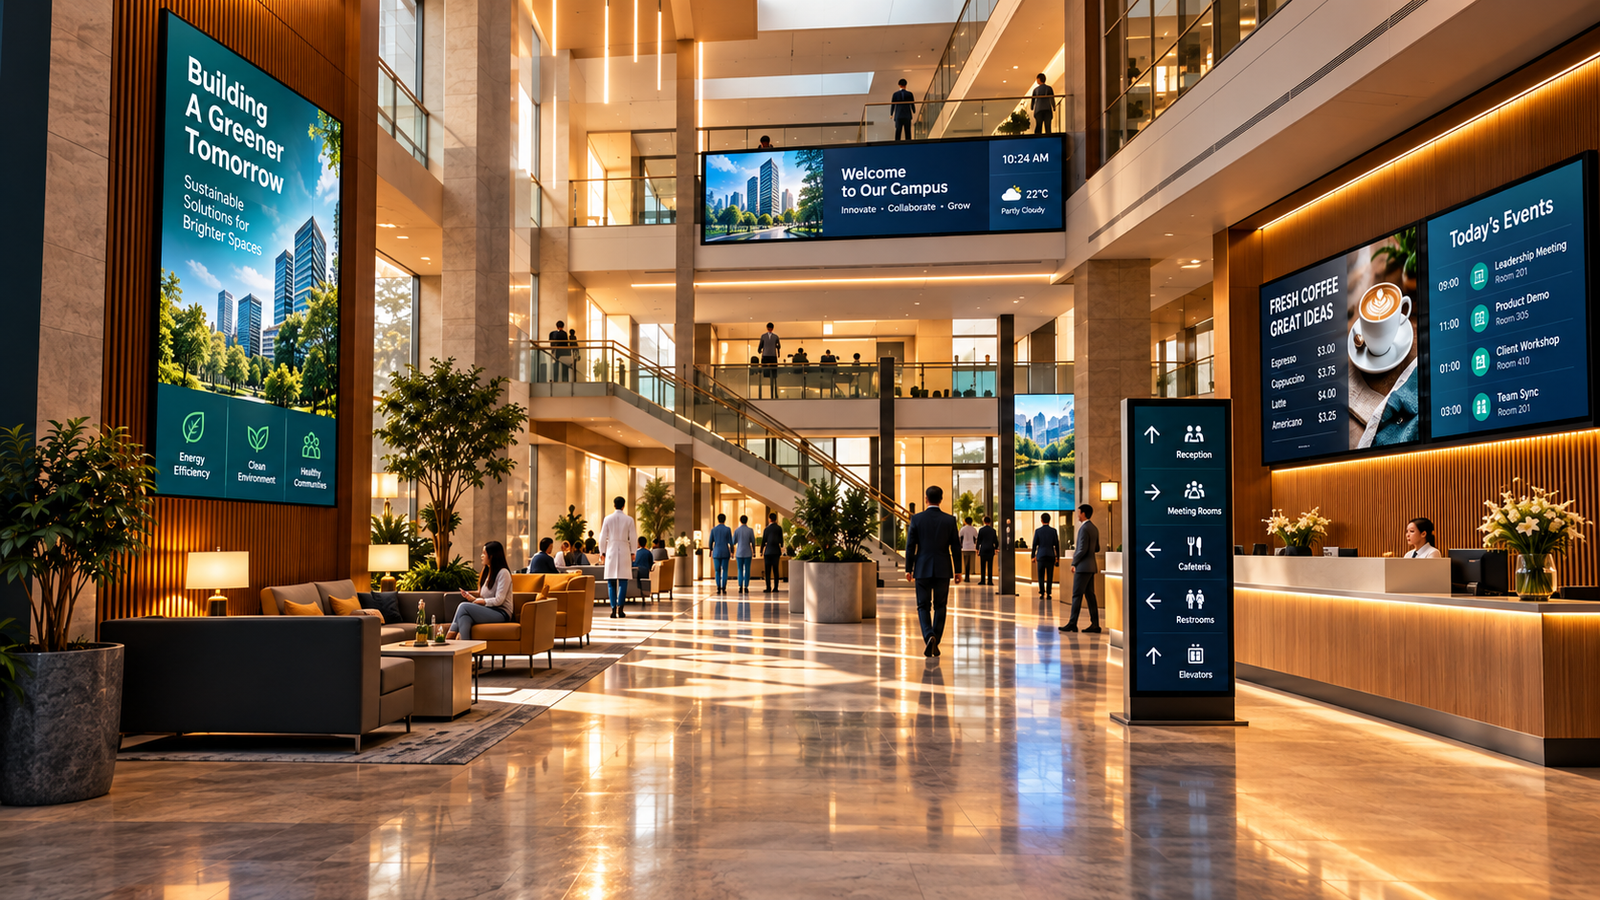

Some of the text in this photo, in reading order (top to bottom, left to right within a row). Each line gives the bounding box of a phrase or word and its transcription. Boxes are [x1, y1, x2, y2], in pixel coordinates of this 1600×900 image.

[188, 56, 267, 128] Building
[185, 93, 284, 163] A Greener
[185, 126, 284, 195] Tomorrow
[1003, 153, 1049, 164] 10:24 AM
[842, 167, 907, 181] Welcome
[184, 175, 244, 212] Sustainable
[842, 183, 949, 198] to Our Campus
[183, 195, 249, 232] Solutions for
[842, 202, 971, 214] Innovate Collaborate Grow
[1002, 206, 1046, 216] Partly Cloudy
[1450, 199, 1554, 248] Today's Events
[183, 214, 262, 256] Brighter Spaces
[1495, 242, 1567, 271] Leadership Meeting
[1495, 267, 1528, 284] Room 201
[1439, 277, 1460, 292] 09:00
[1270, 276, 1339, 315] FRESH COFFEE
[1496, 291, 1550, 312] Product Demo
[1270, 303, 1334, 337] GREAT IDEAS
[1439, 318, 1460, 332] 11:00
[1496, 310, 1529, 326] Room 305
[1496, 336, 1560, 357] Client Workshop
[1271, 343, 1336, 369] Espresso $3.00
[1497, 355, 1530, 370] Room 410
[1440, 361, 1461, 374] 01:00
[1271, 365, 1337, 390] Cappuccino $3.75
[1272, 388, 1337, 410] Latte $4.00
[1497, 389, 1540, 403] Team Sync
[1441, 404, 1462, 417] 03:00
[1498, 404, 1531, 417] Room 201
[1272, 410, 1337, 430] Americano $3.25
[179, 452, 205, 466] Energy
[1177, 451, 1213, 461] Reception
[173, 466, 210, 479] Efficiency
[248, 461, 267, 471] Clean
[238, 472, 276, 485] Environment
[1168, 507, 1222, 517] Meeting Rooms
[1179, 563, 1212, 571] Cafeteria
[1177, 616, 1215, 624] Restrooms
[1179, 671, 1214, 679] Elevators
